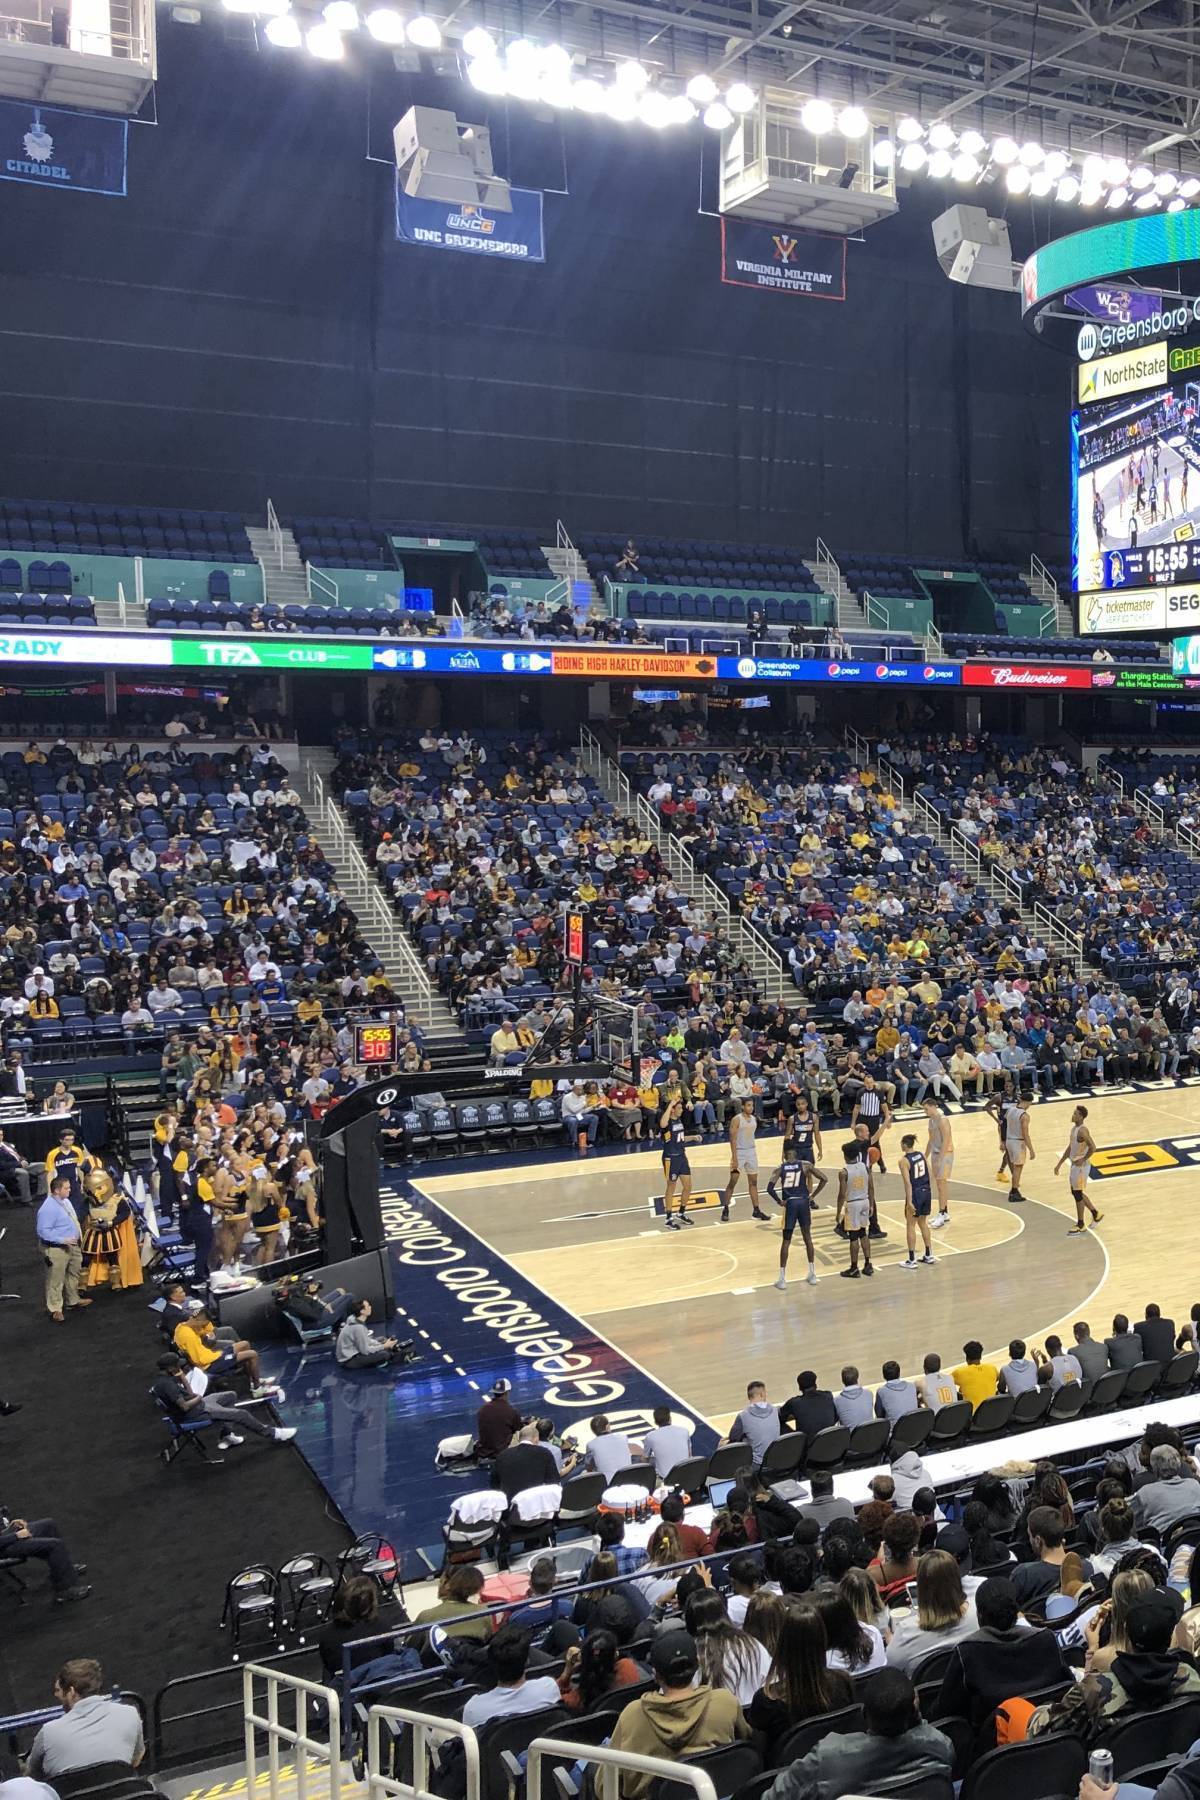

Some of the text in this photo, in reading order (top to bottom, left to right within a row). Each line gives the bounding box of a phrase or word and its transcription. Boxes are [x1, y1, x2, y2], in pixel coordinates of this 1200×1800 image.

[6, 159, 71, 180] CITADEL
[449, 215, 494, 233] UNCG
[414, 227, 528, 256] UNC GREENSBORO
[736, 260, 833, 284] VIRGINIA MILITARY
[758, 275, 812, 291] INSTITUTE
[1100, 306, 1188, 347] Greensboro
[1103, 358, 1165, 387] NorthState
[1147, 545, 1188, 572] 15:55
[1106, 598, 1154, 613] ticketmaster
[199, 643, 328, 665] TFA CLUB
[554, 655, 584, 671] RIDING
[587, 657, 608, 671] HIGH
[757, 661, 800, 671] Greensboro
[757, 669, 792, 677] Coliseum
[841, 667, 860, 676] pepsi
[889, 668, 908, 677] pepsi
[936, 670, 953, 679] pepsi
[991, 668, 1068, 685] Budweiser
[1120, 671, 1151, 682] Charging
[1152, 673, 1176, 681] Statio
[362, 1028, 391, 1042] 15:55
[364, 1043, 386, 1058] 30
[484, 1067, 523, 1078] SPALDING
[799, 1132, 806, 1142] 2
[914, 1162, 926, 1179] 13
[784, 1171, 802, 1188] 21
[436, 1267, 625, 1407] Greensboro
[937, 1386, 953, 1404] 10
